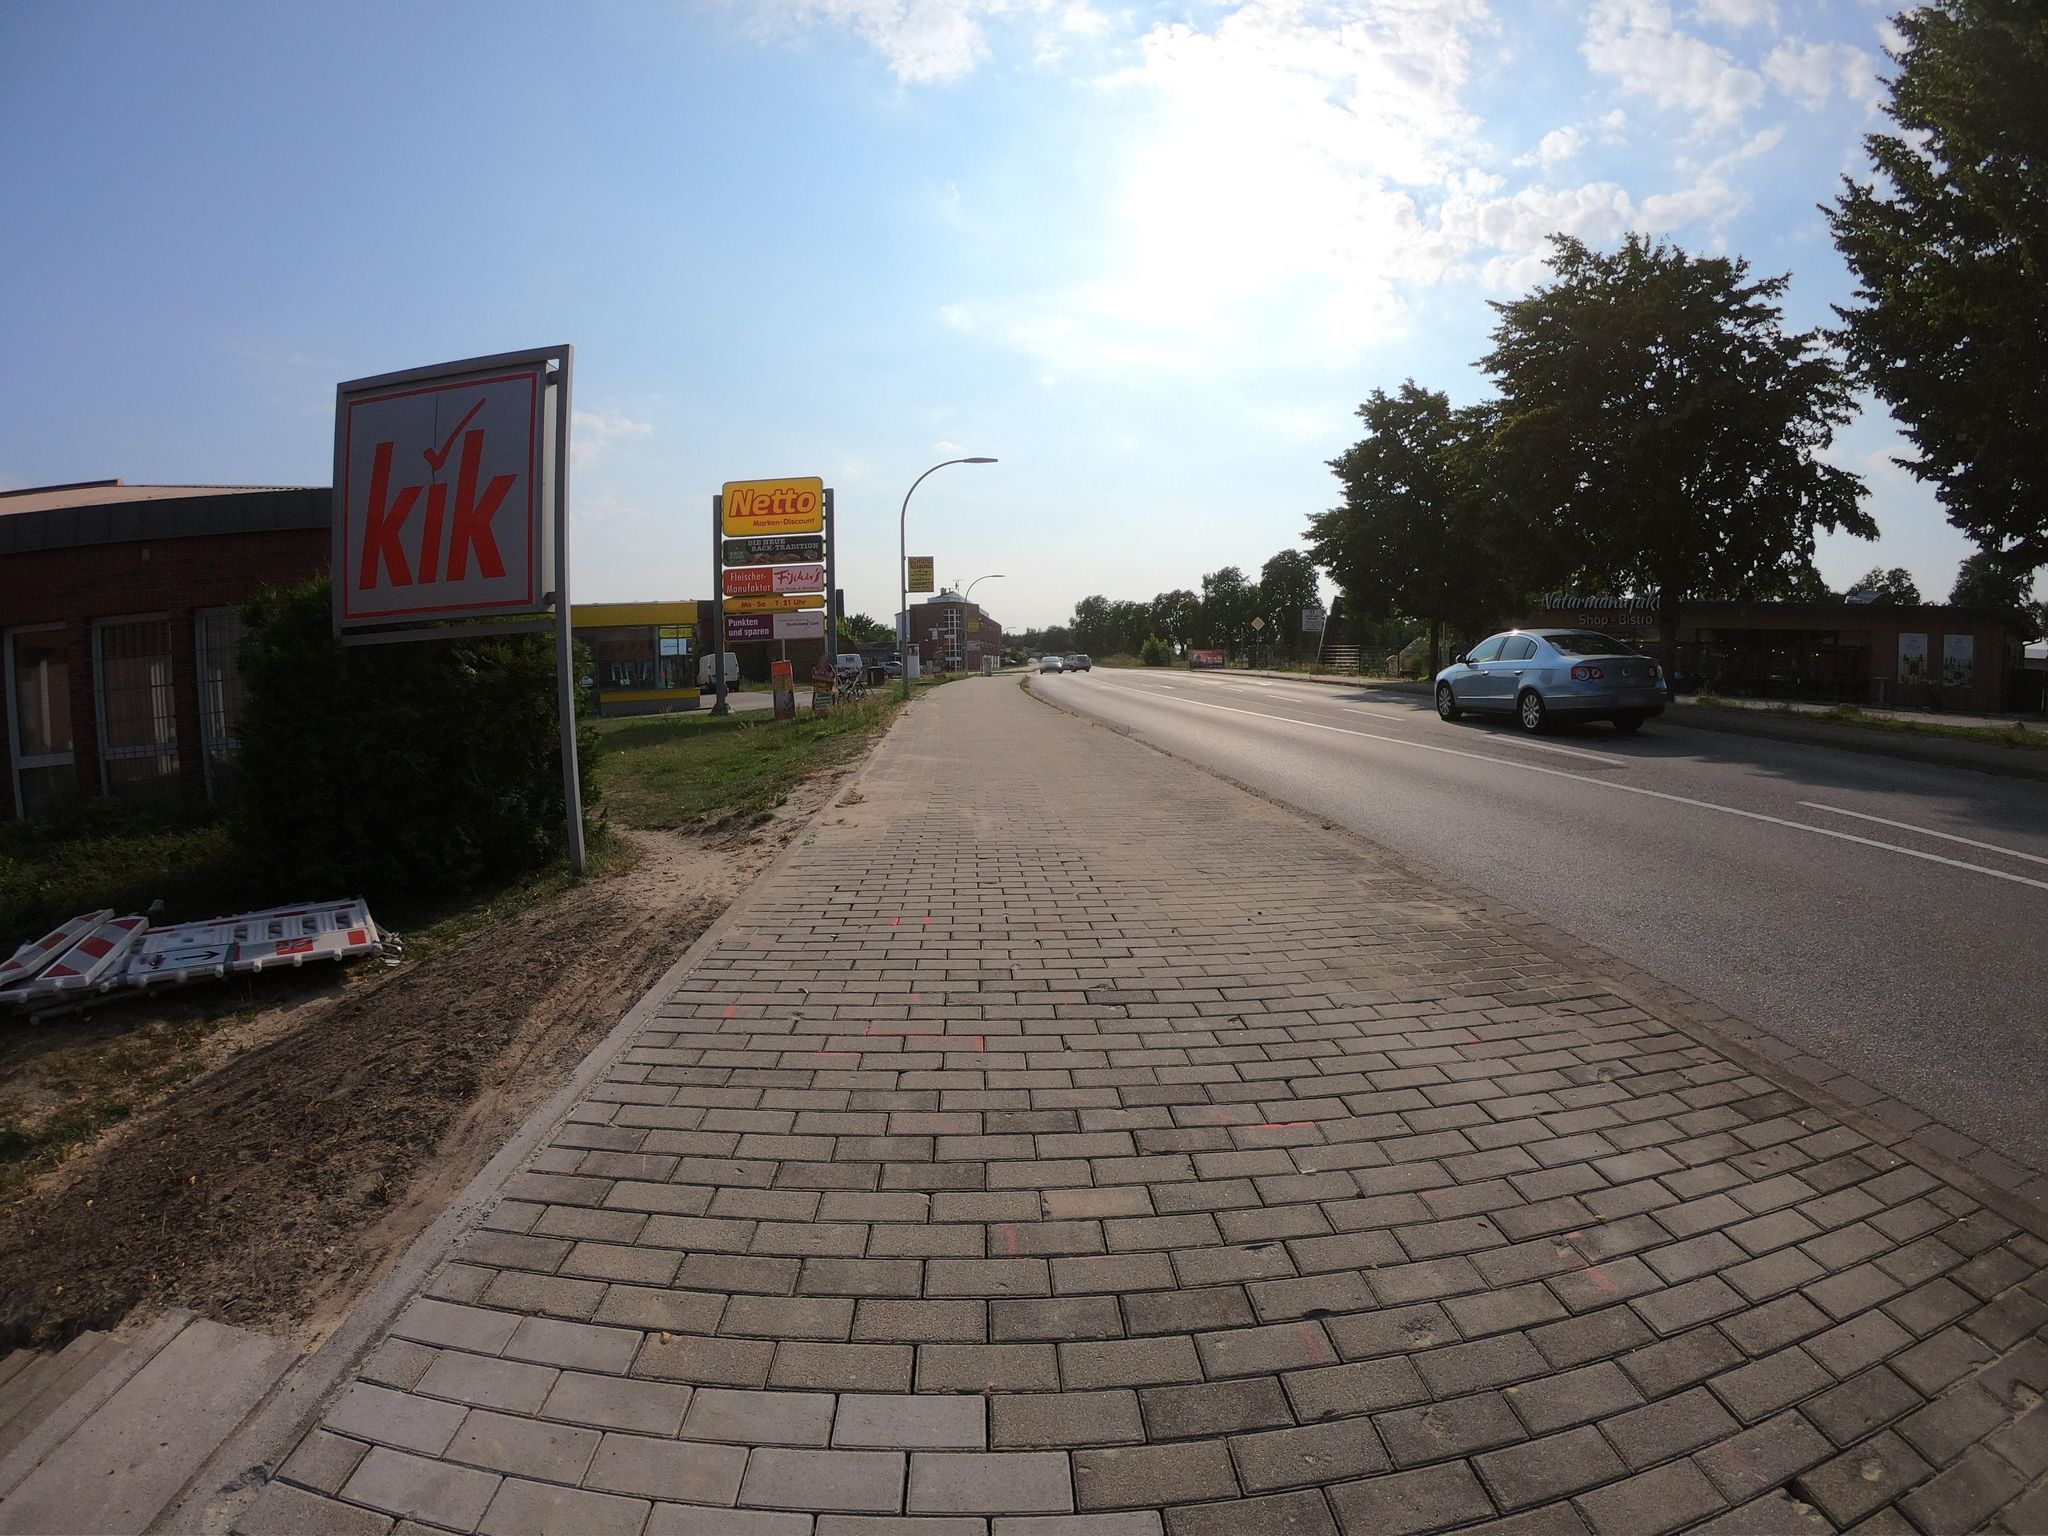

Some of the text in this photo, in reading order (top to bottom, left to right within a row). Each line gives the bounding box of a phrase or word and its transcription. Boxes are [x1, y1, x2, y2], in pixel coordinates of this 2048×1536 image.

[359, 396, 518, 590] kik
[729, 488, 816, 517] Netto
[730, 571, 767, 582] Fleischer-
[726, 583, 771, 594] Manufaktur
[728, 618, 759, 628] Punkten
[1579, 615, 1609, 627] Shop
[1619, 613, 1653, 625] Bistro
[728, 628, 770, 638] und sparen
